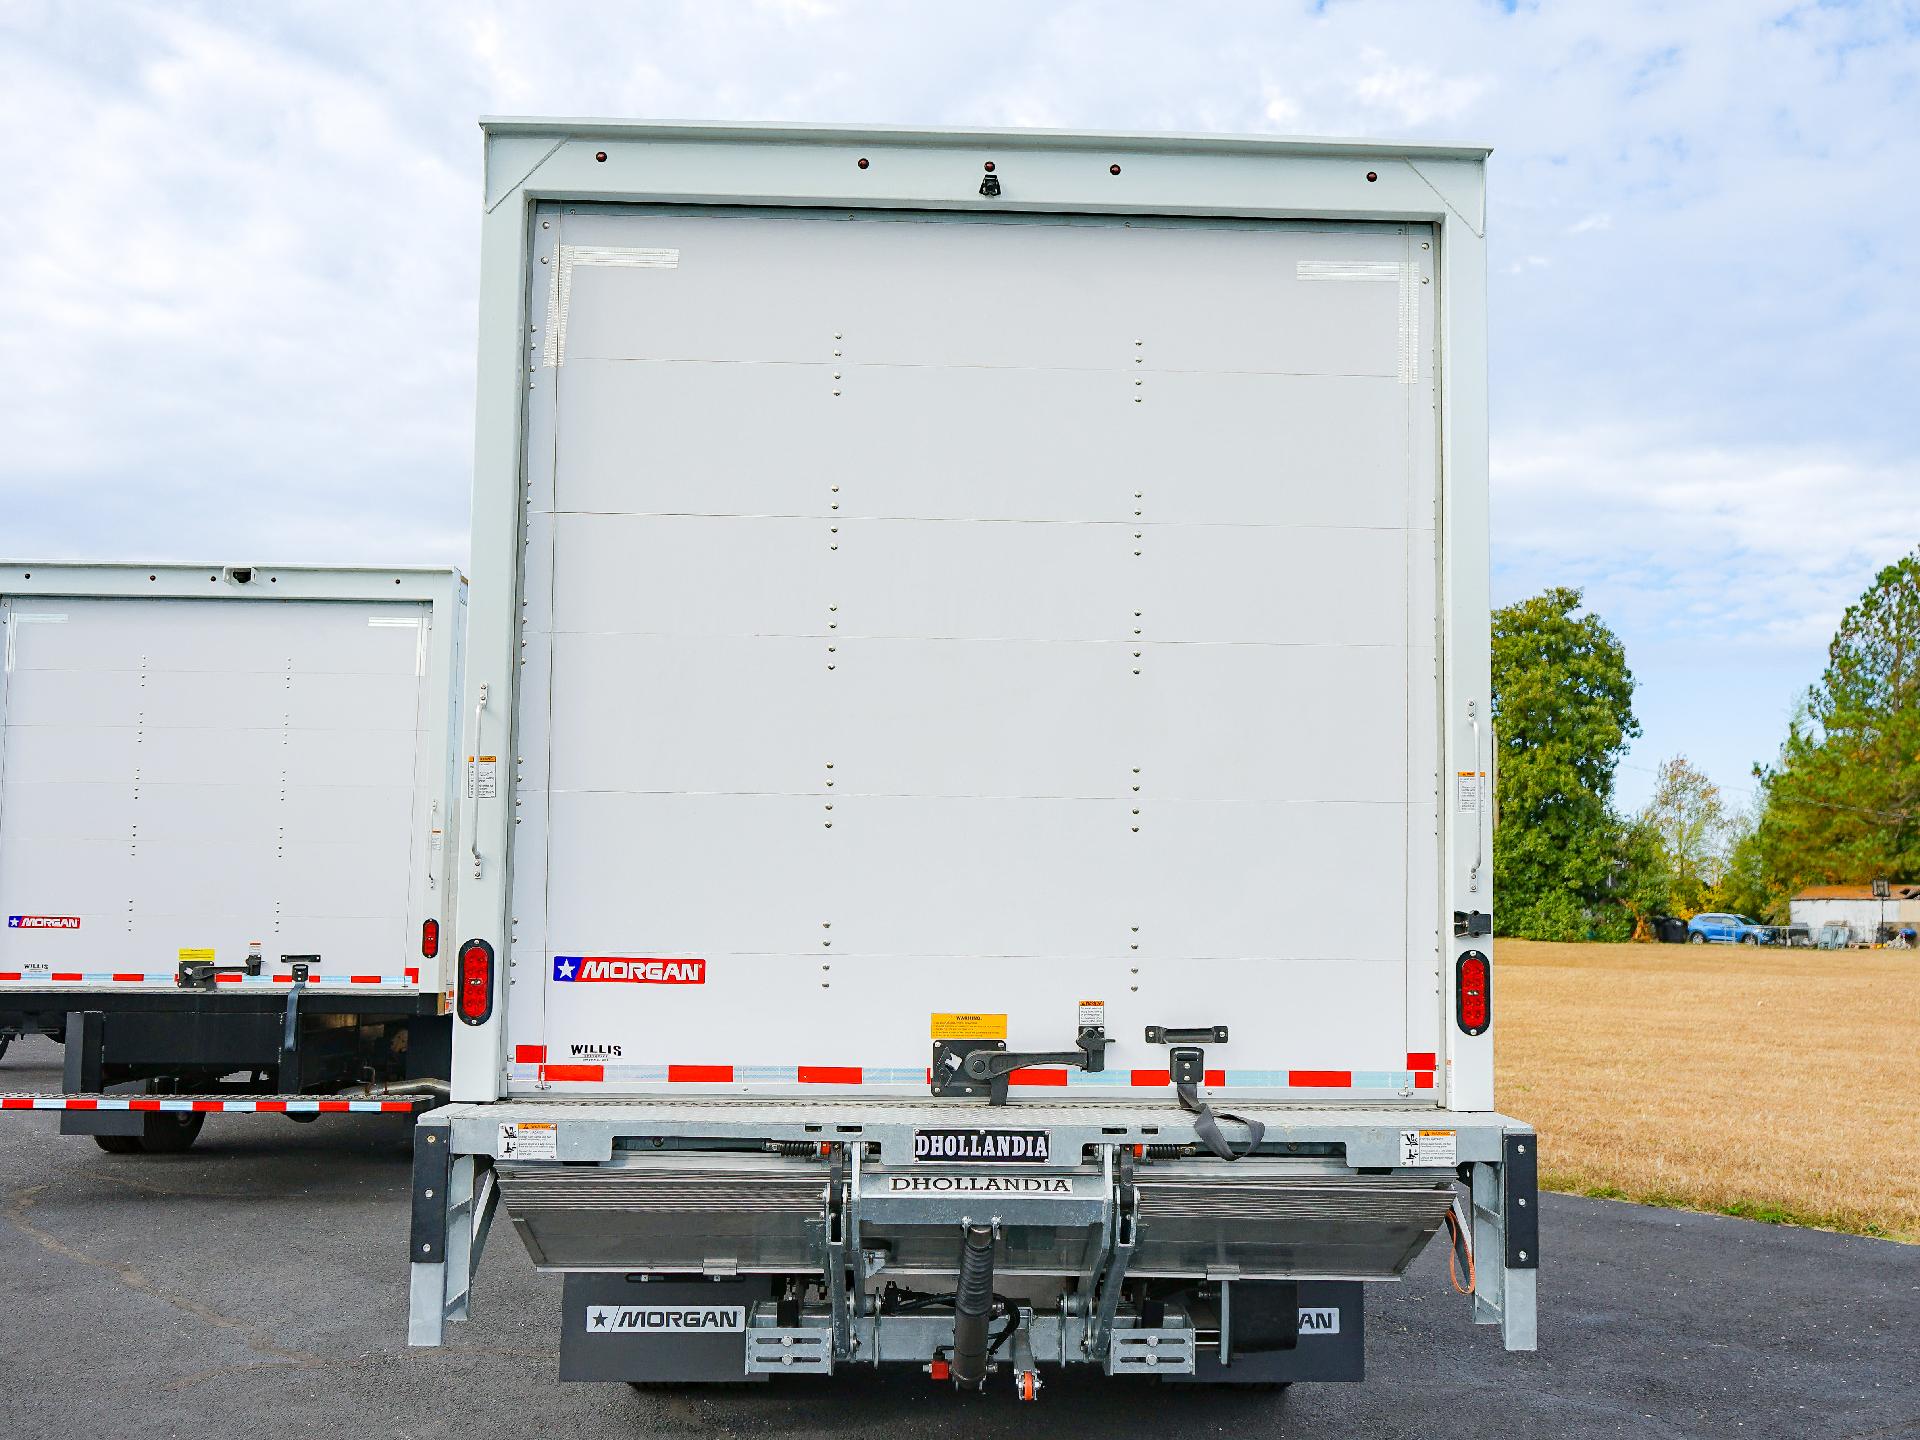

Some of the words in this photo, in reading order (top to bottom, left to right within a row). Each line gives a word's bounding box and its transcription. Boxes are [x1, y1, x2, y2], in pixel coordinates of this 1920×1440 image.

[21, 918, 78, 928] MORGAN
[581, 960, 701, 982] MORGAN
[570, 1044, 622, 1056] WILLIS
[915, 1135, 1048, 1158] DHOLLANDIA
[891, 1176, 1071, 1193] DHOLLANDIA
[617, 1311, 738, 1328] MORGAN
